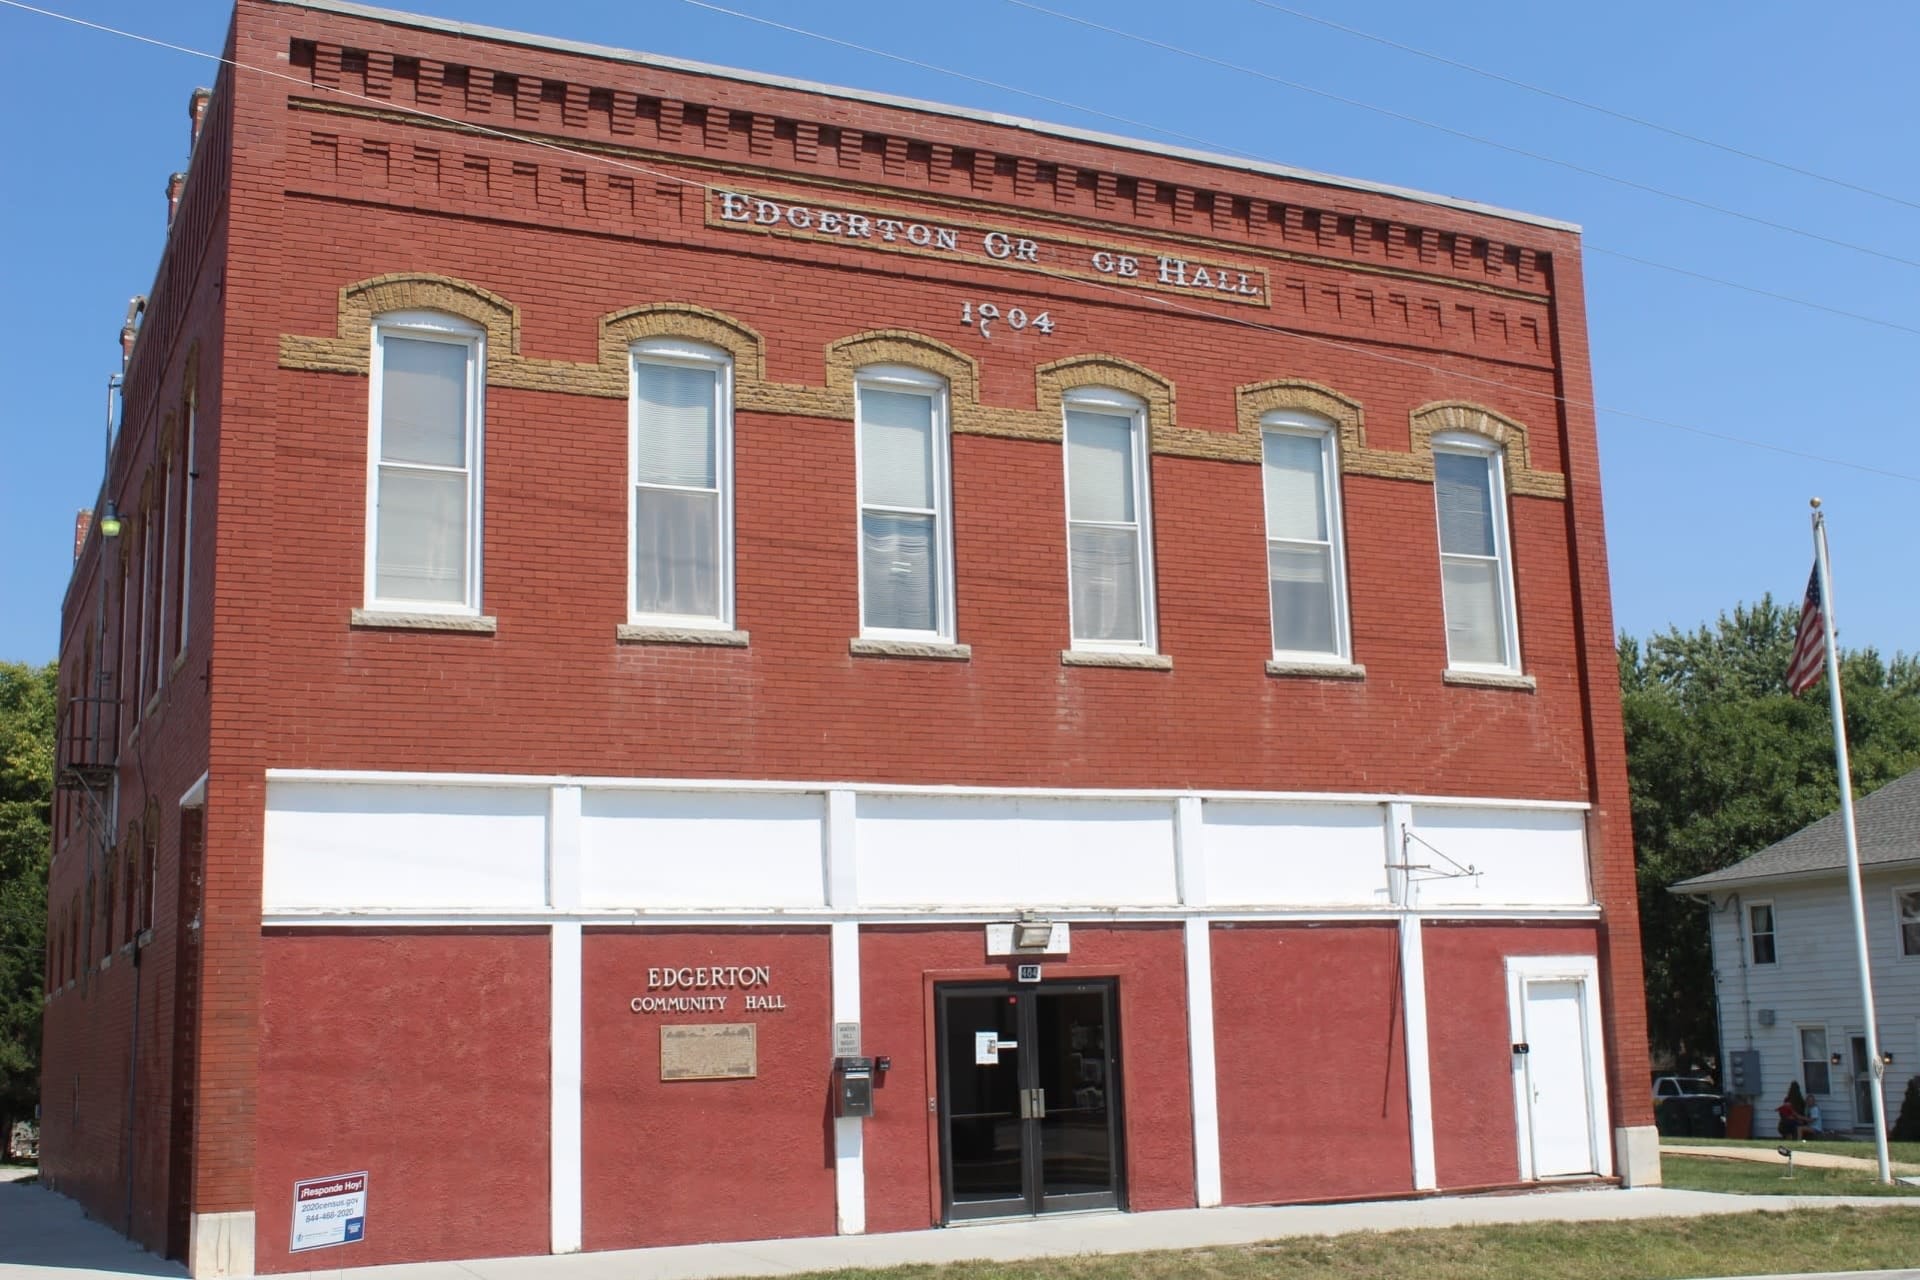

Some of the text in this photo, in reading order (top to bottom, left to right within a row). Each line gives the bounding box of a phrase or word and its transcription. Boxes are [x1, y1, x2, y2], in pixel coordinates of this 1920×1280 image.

[719, 192, 960, 250] EDGERTON
[960, 301, 1055, 338] 1904
[648, 966, 770, 987] EDGERTON
[631, 995, 786, 1012] COMMUNITY HALL
[345, 1180, 362, 1190] Hoy!
